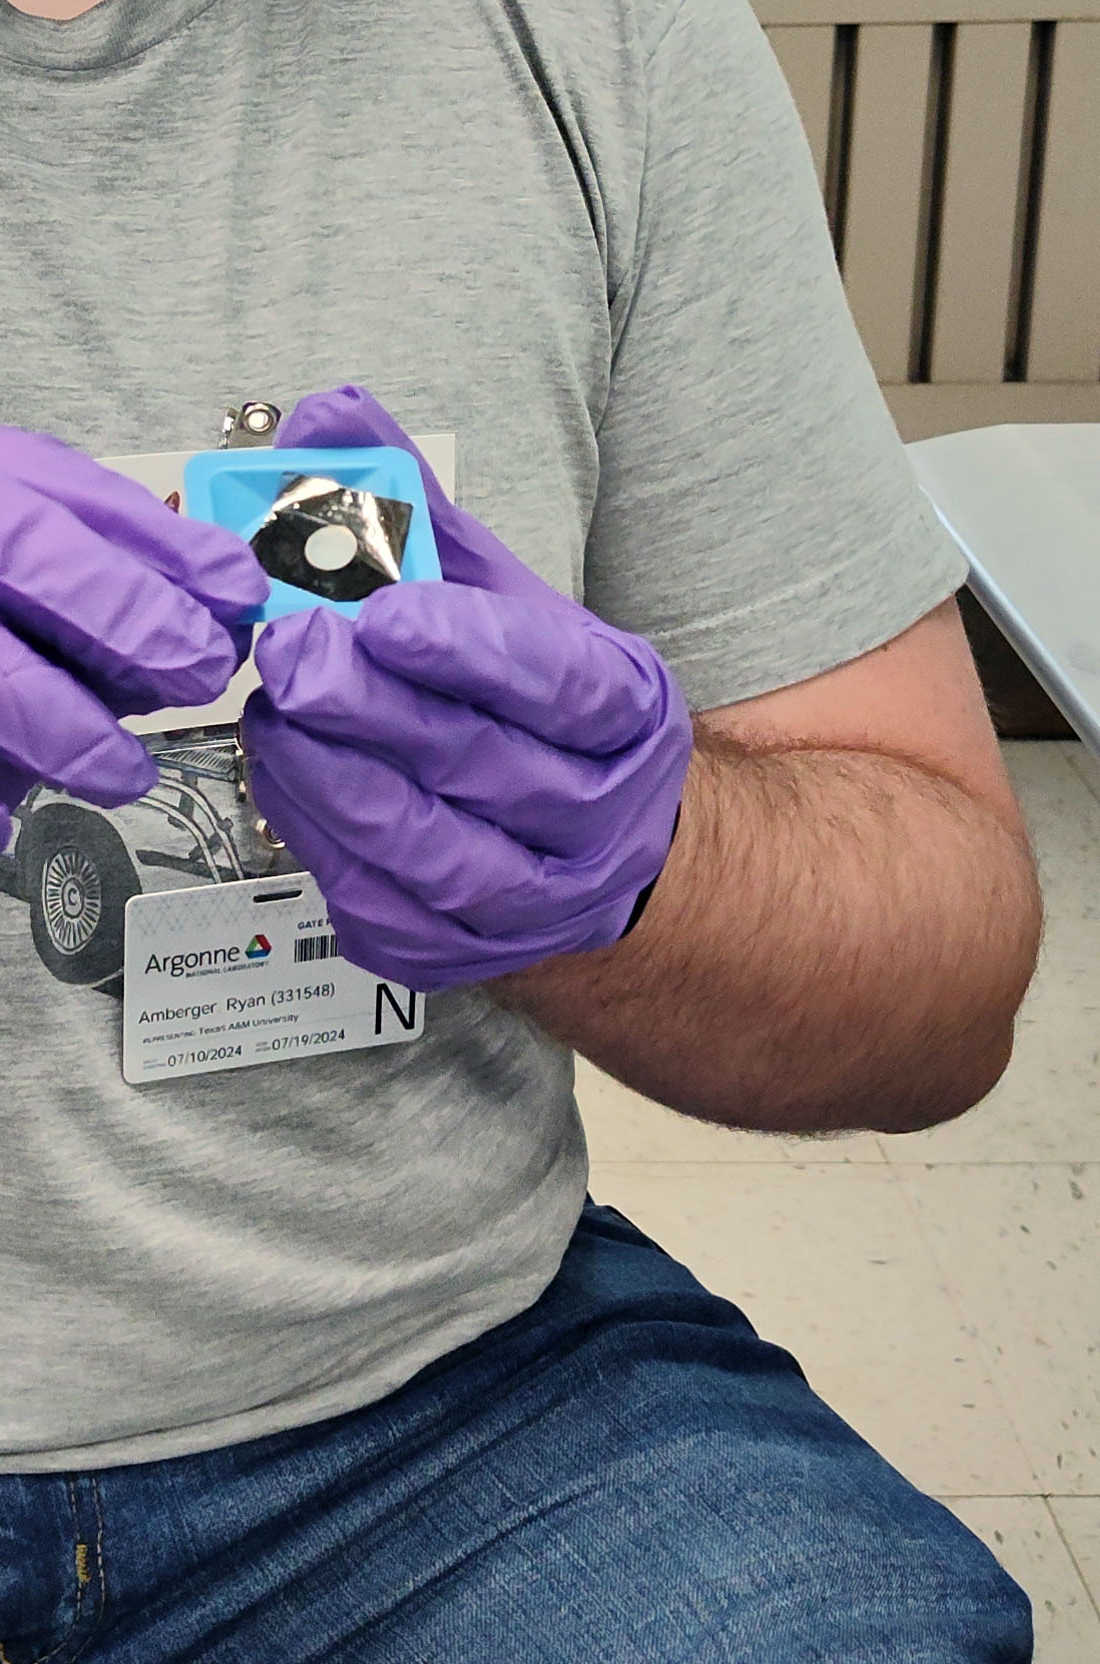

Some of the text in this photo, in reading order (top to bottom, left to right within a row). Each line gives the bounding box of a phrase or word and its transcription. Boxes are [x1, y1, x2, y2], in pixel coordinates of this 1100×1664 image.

[297, 918, 324, 930] GATE
[144, 946, 241, 978] Argonne
[138, 982, 336, 1025] Amberger Ryan (331548)
[374, 982, 417, 1035] N
[199, 1024, 227, 1036] Texas
[271, 1028, 346, 1052] 07/19/2024
[167, 1044, 243, 1068] 07/10/2024
